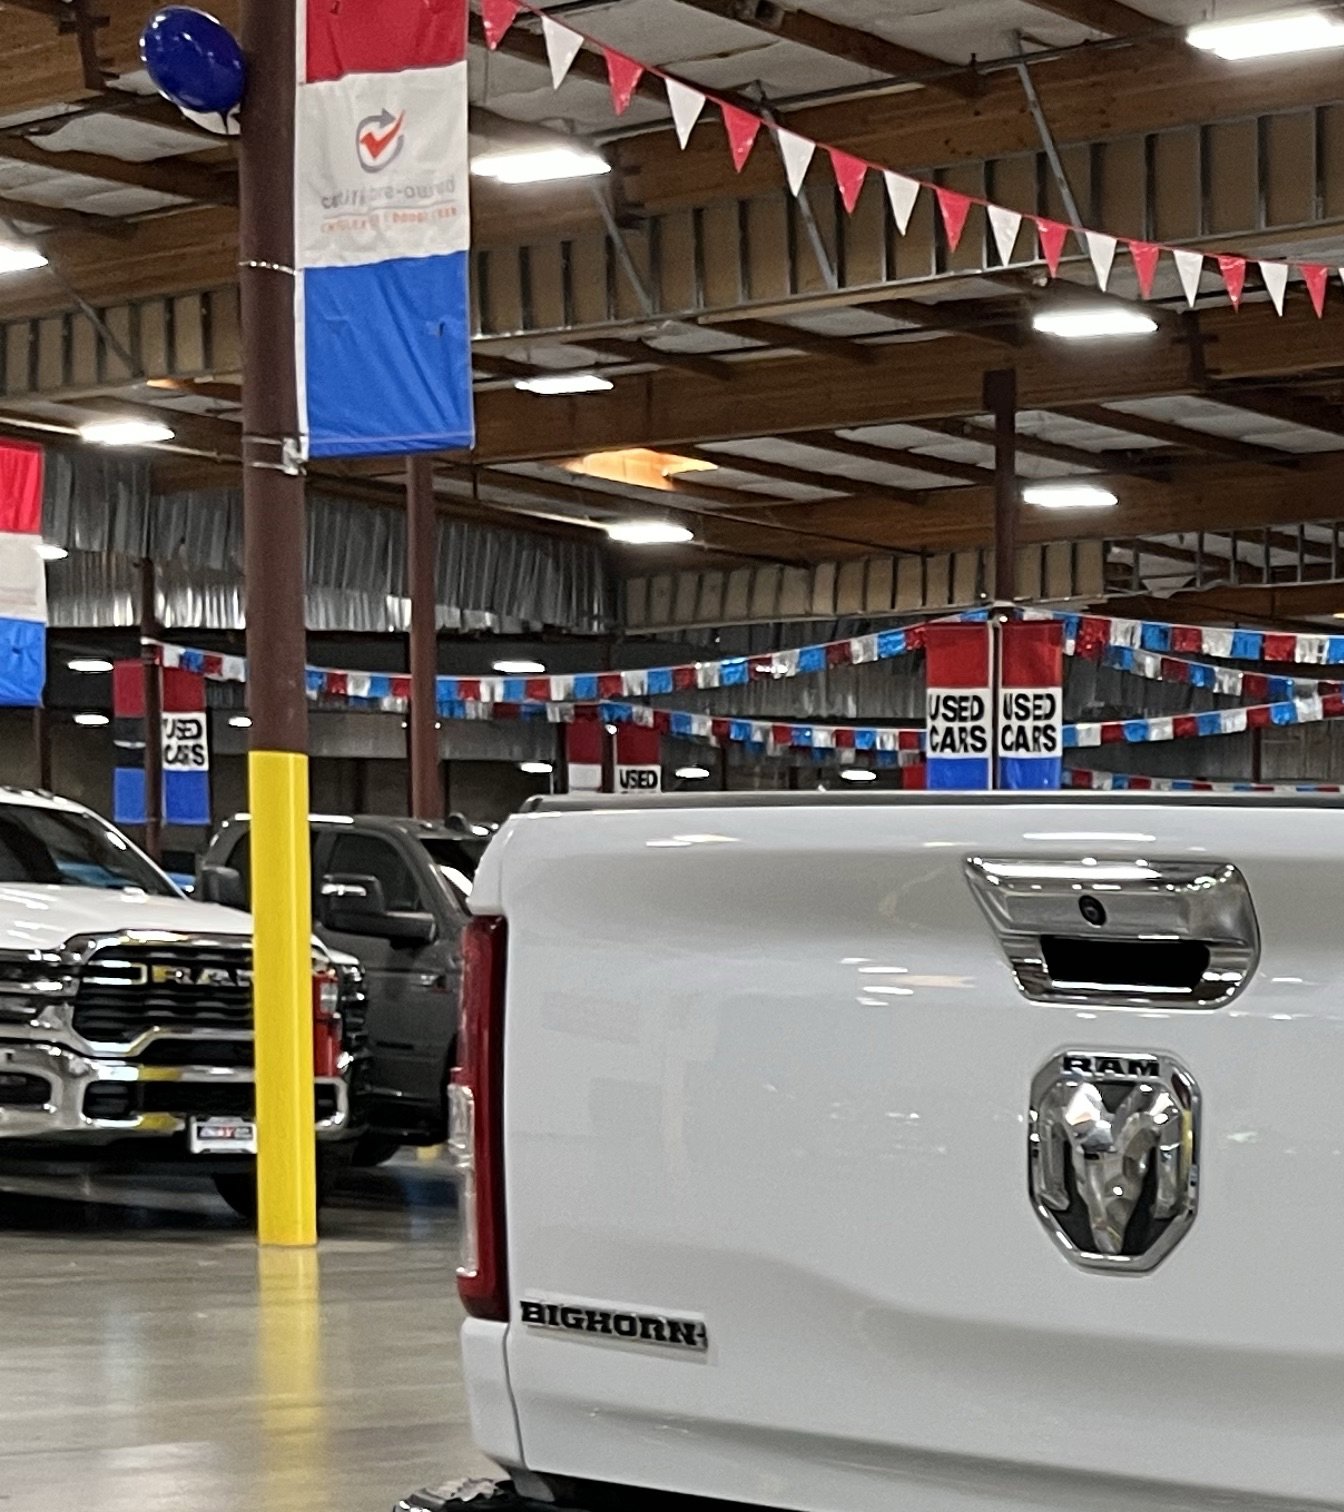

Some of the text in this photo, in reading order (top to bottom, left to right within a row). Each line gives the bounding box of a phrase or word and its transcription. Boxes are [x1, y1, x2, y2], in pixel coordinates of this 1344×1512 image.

[929, 694, 985, 722] USED
[1003, 693, 1056, 721] USED
[929, 725, 987, 752] CARS
[1001, 724, 1057, 752] CARS
[619, 768, 658, 789] USED
[1063, 1057, 1160, 1077] RAM
[520, 1301, 698, 1346] BIGHORN
